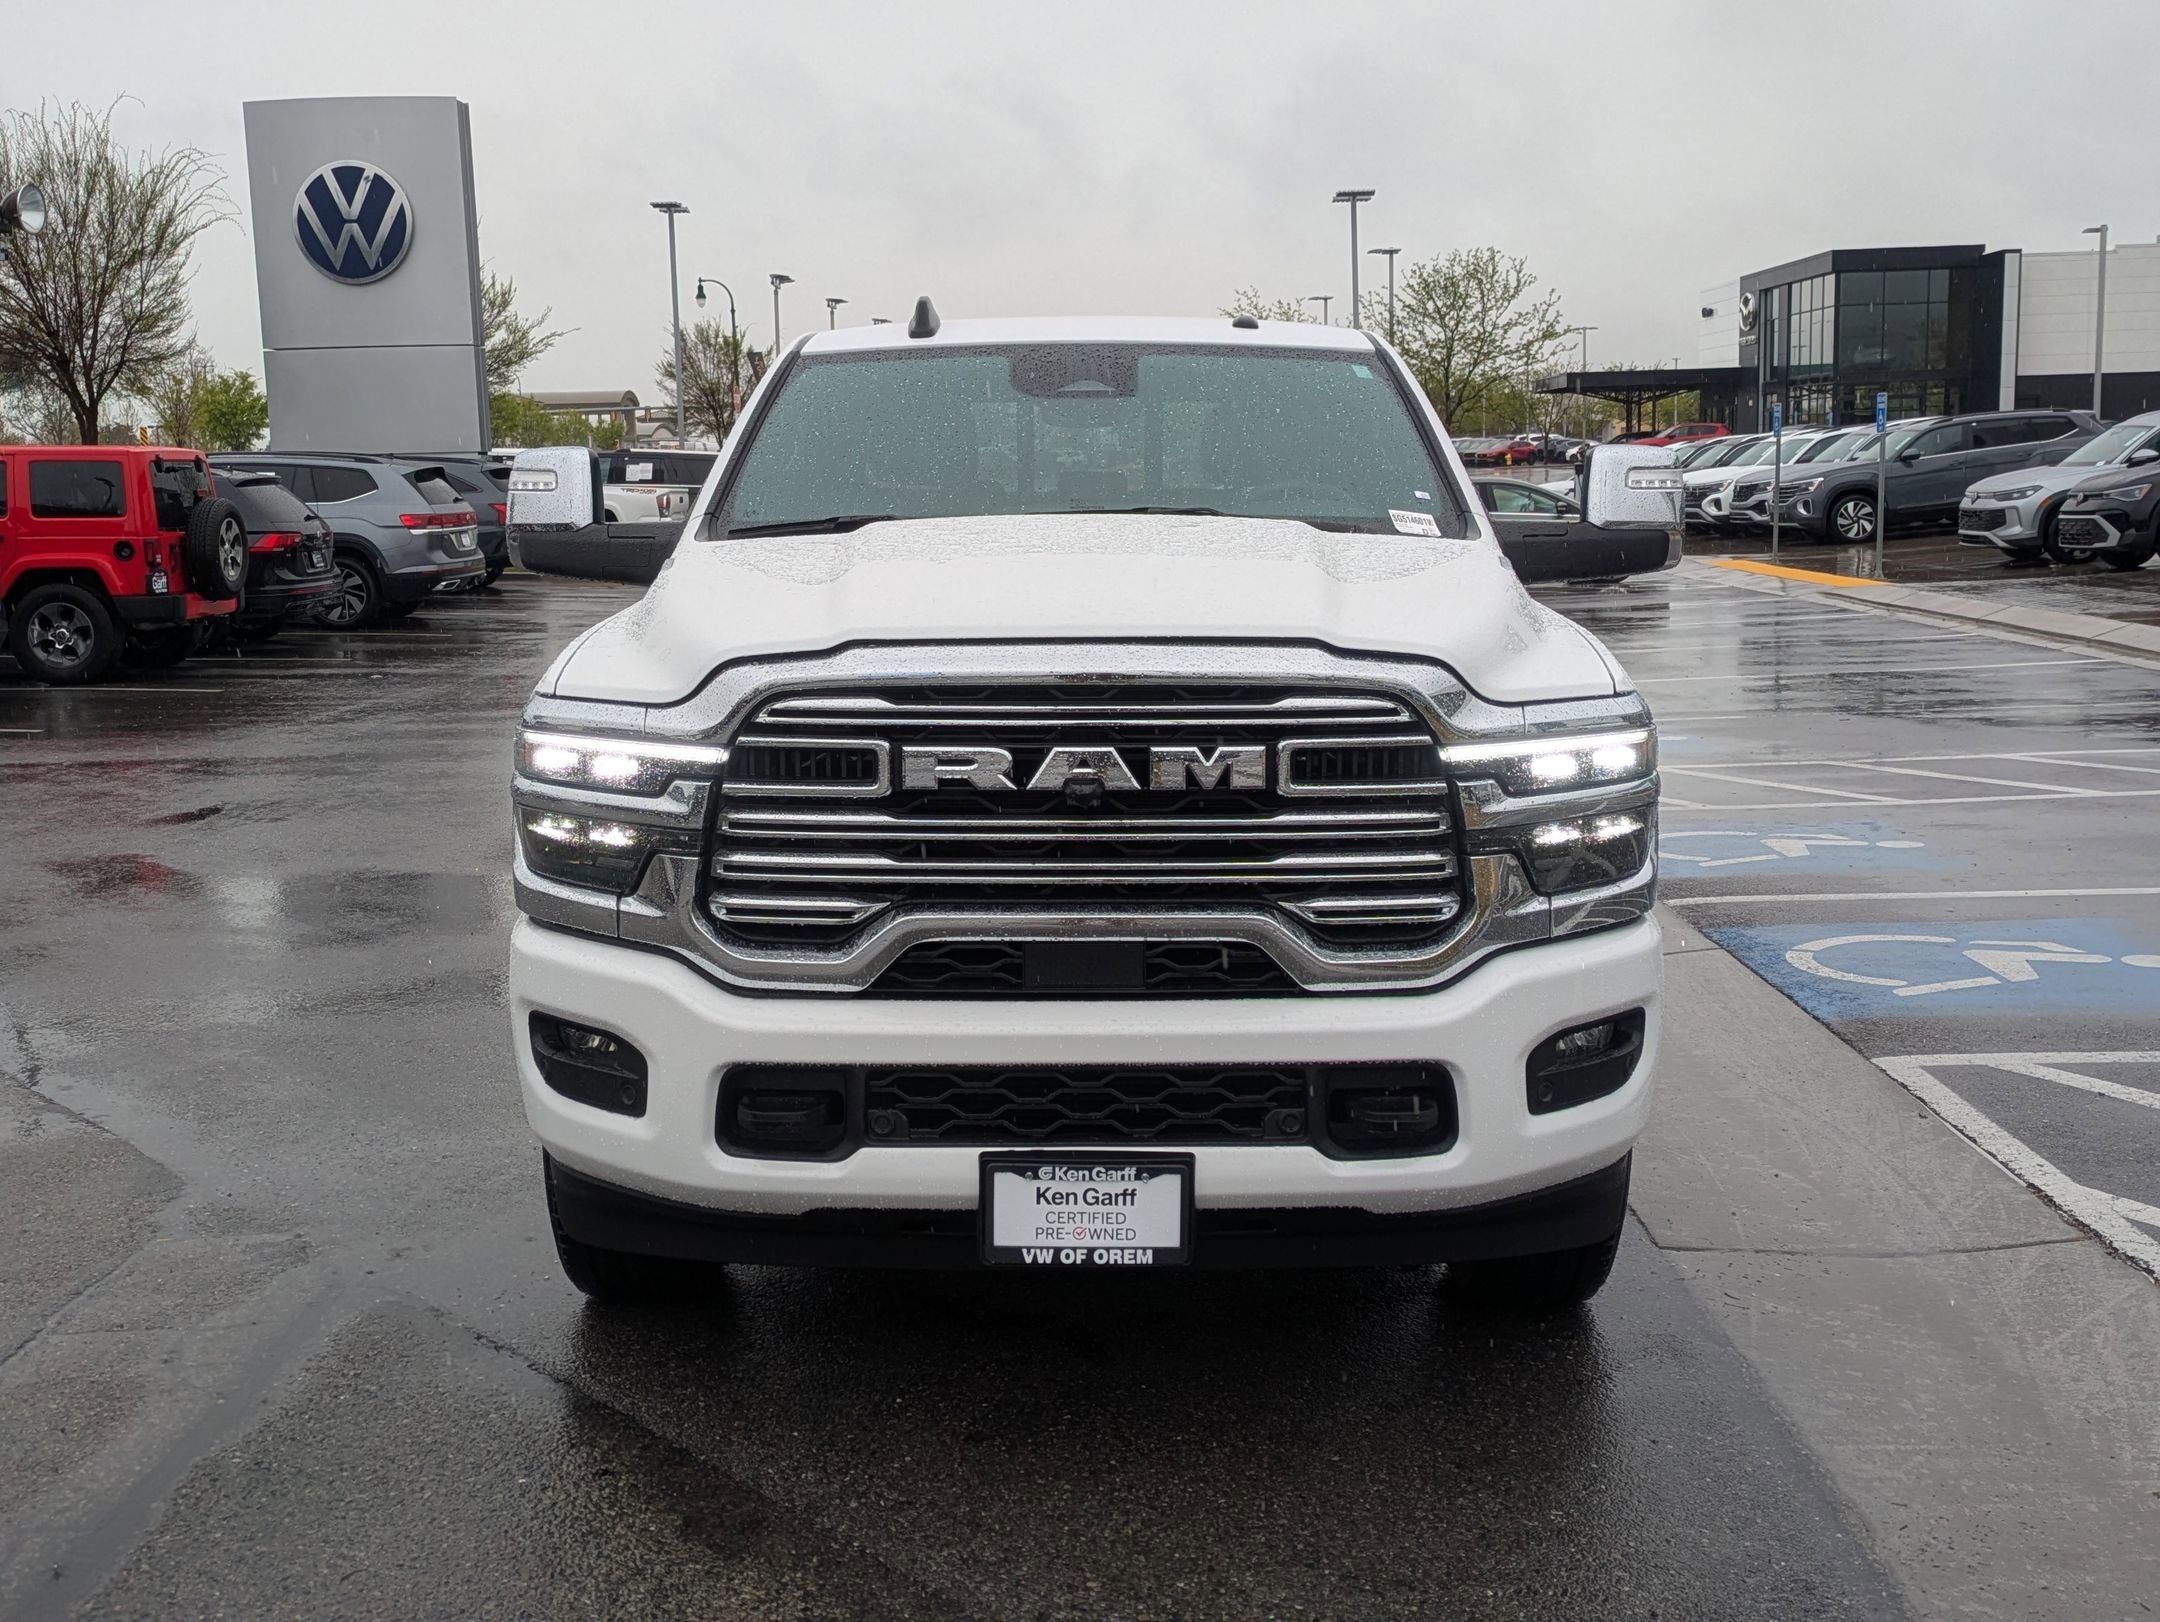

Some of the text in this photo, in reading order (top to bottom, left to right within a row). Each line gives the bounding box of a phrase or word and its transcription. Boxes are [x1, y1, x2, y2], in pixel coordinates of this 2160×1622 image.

[902, 746, 1267, 790] RAM
[1055, 1167, 1137, 1182] Ken Garff
[1036, 1187, 1138, 1207] Ken Garff
[1045, 1211, 1127, 1225] CERTIFIED
[1022, 1248, 1153, 1265] VW OF OREM
